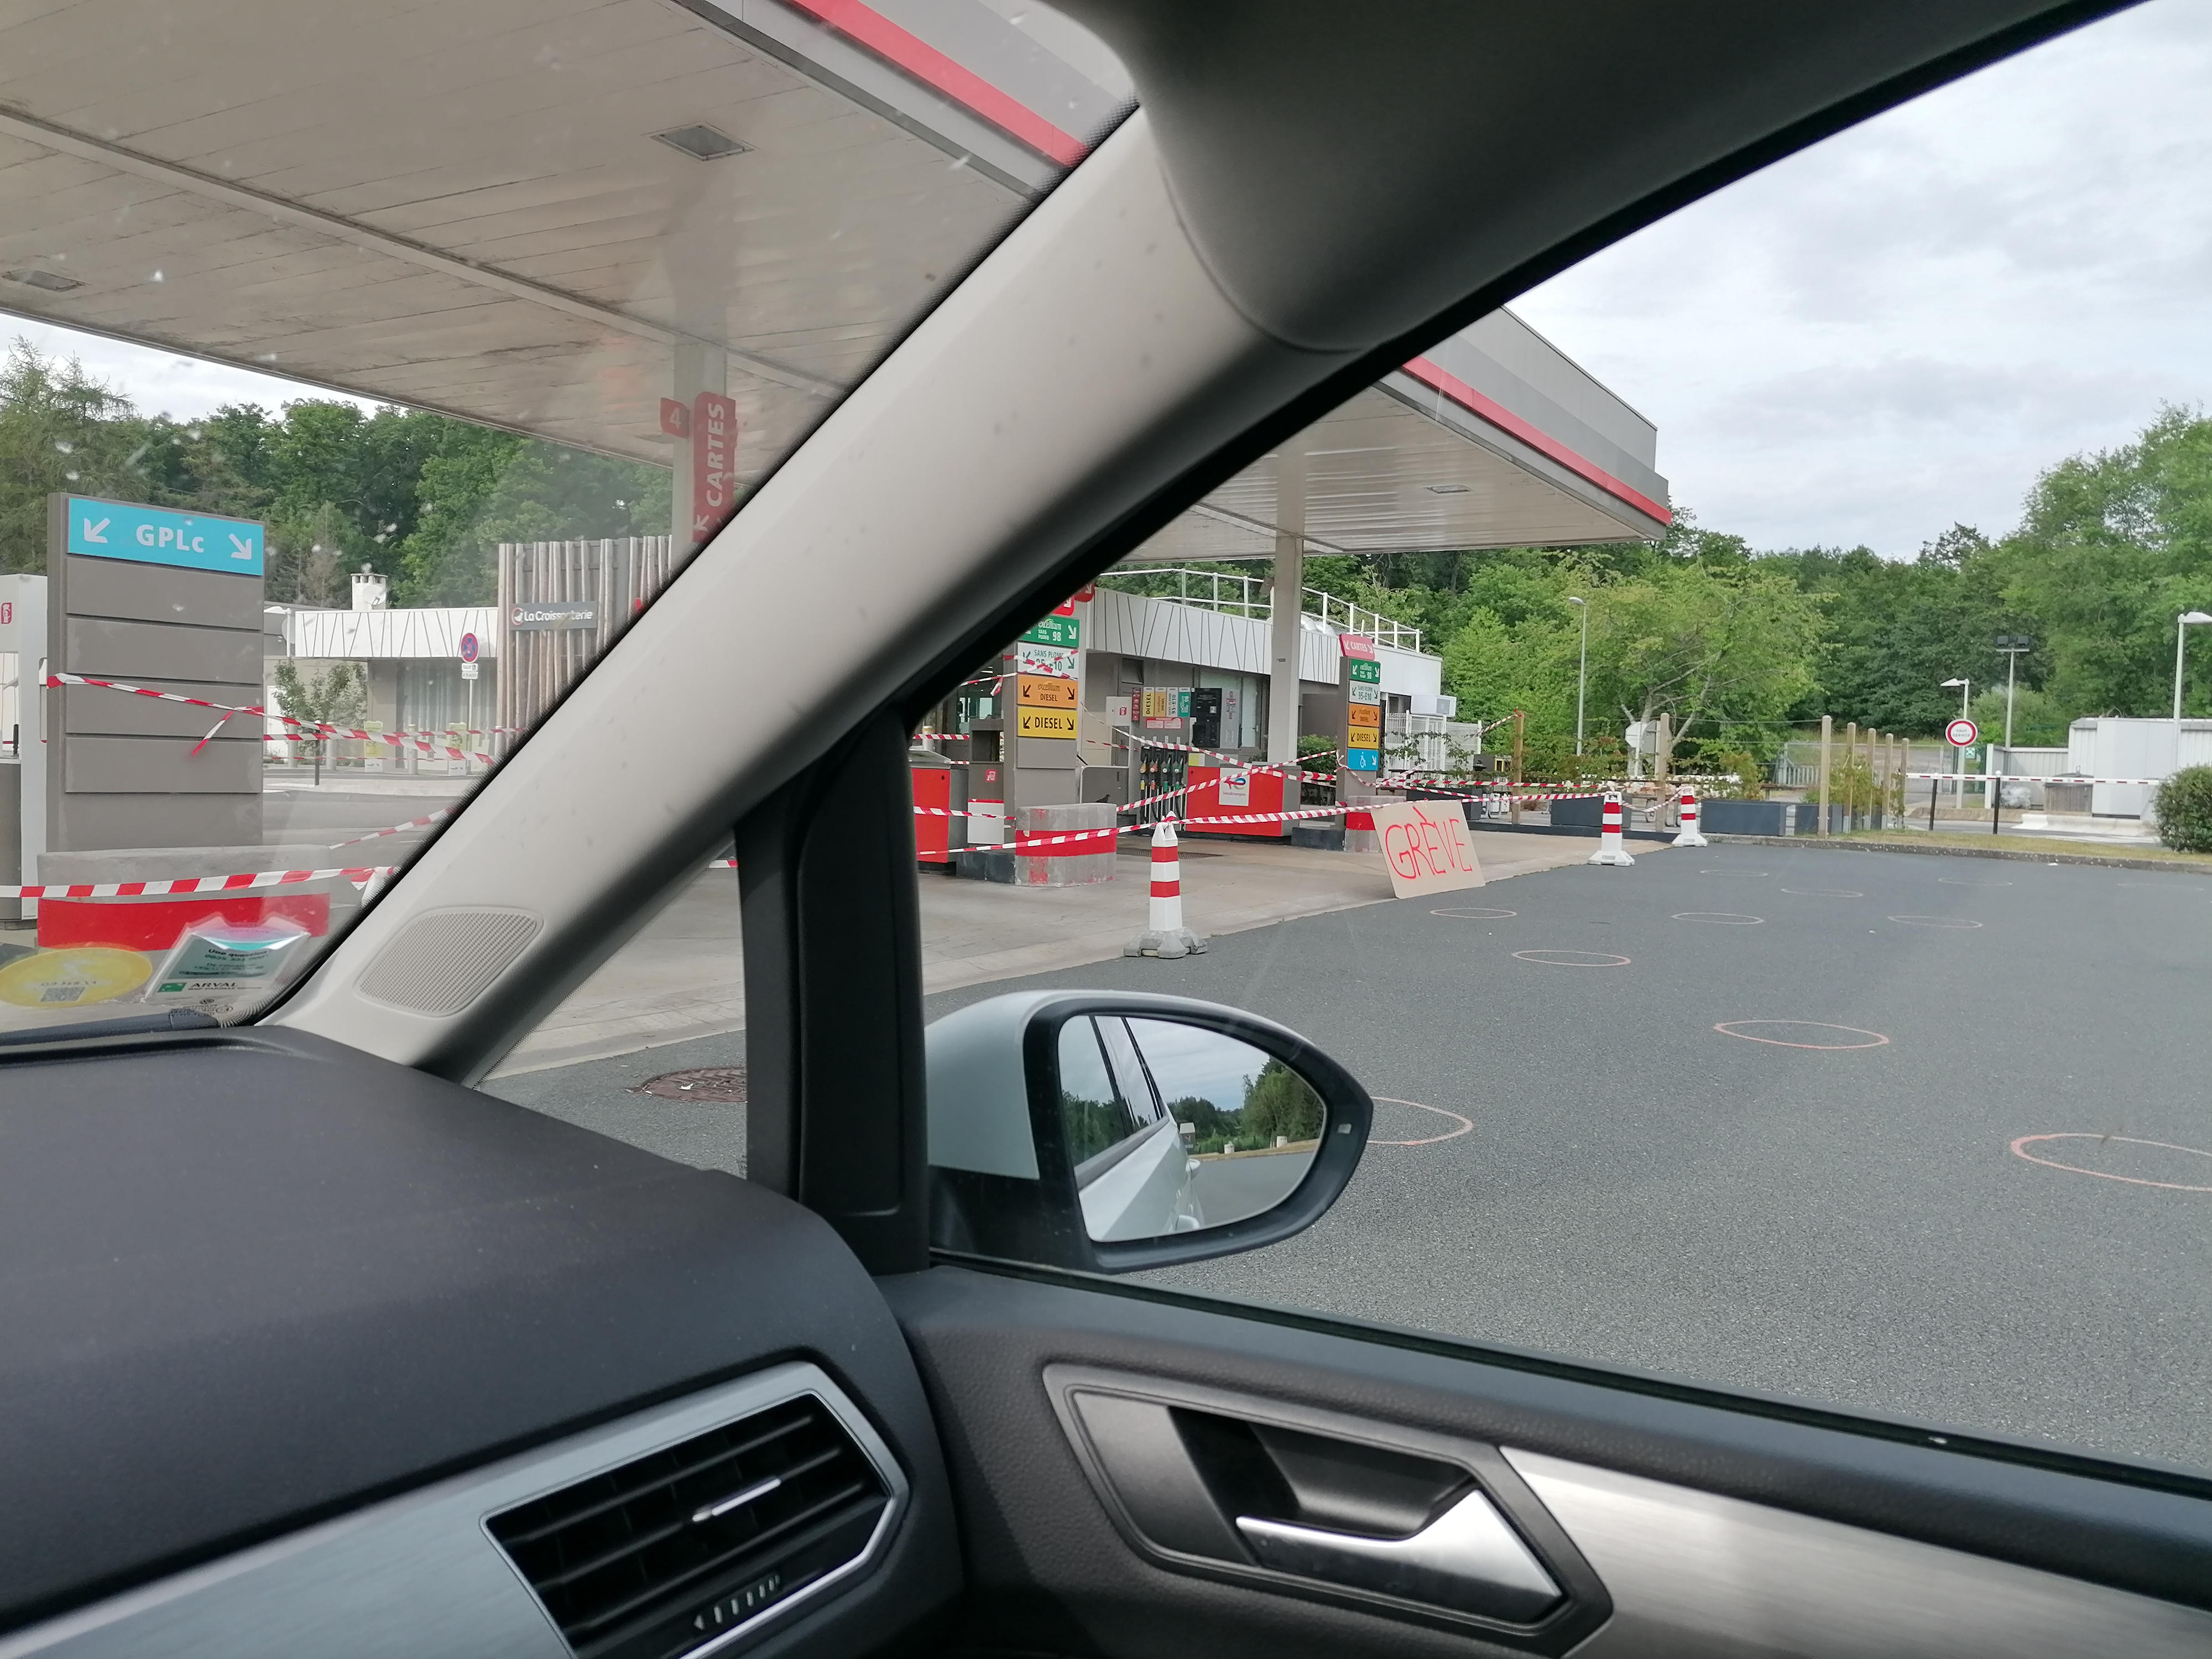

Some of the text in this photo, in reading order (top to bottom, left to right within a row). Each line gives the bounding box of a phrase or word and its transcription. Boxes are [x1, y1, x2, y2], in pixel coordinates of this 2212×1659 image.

[670, 408, 681, 429] 4
[706, 403, 724, 507] CARTES
[136, 524, 204, 553] GPLc
[524, 611, 535, 622] La
[1052, 632, 1061, 641] 98
[1350, 641, 1368, 652] CARTES
[1034, 649, 1047, 658] SANS
[1040, 693, 1058, 702] DIESEL
[1358, 692, 1371, 701] 95-E10
[1035, 717, 1062, 729] DIESEL
[1357, 733, 1370, 742] DIESEL
[1385, 806, 1473, 879] GRÈVE
